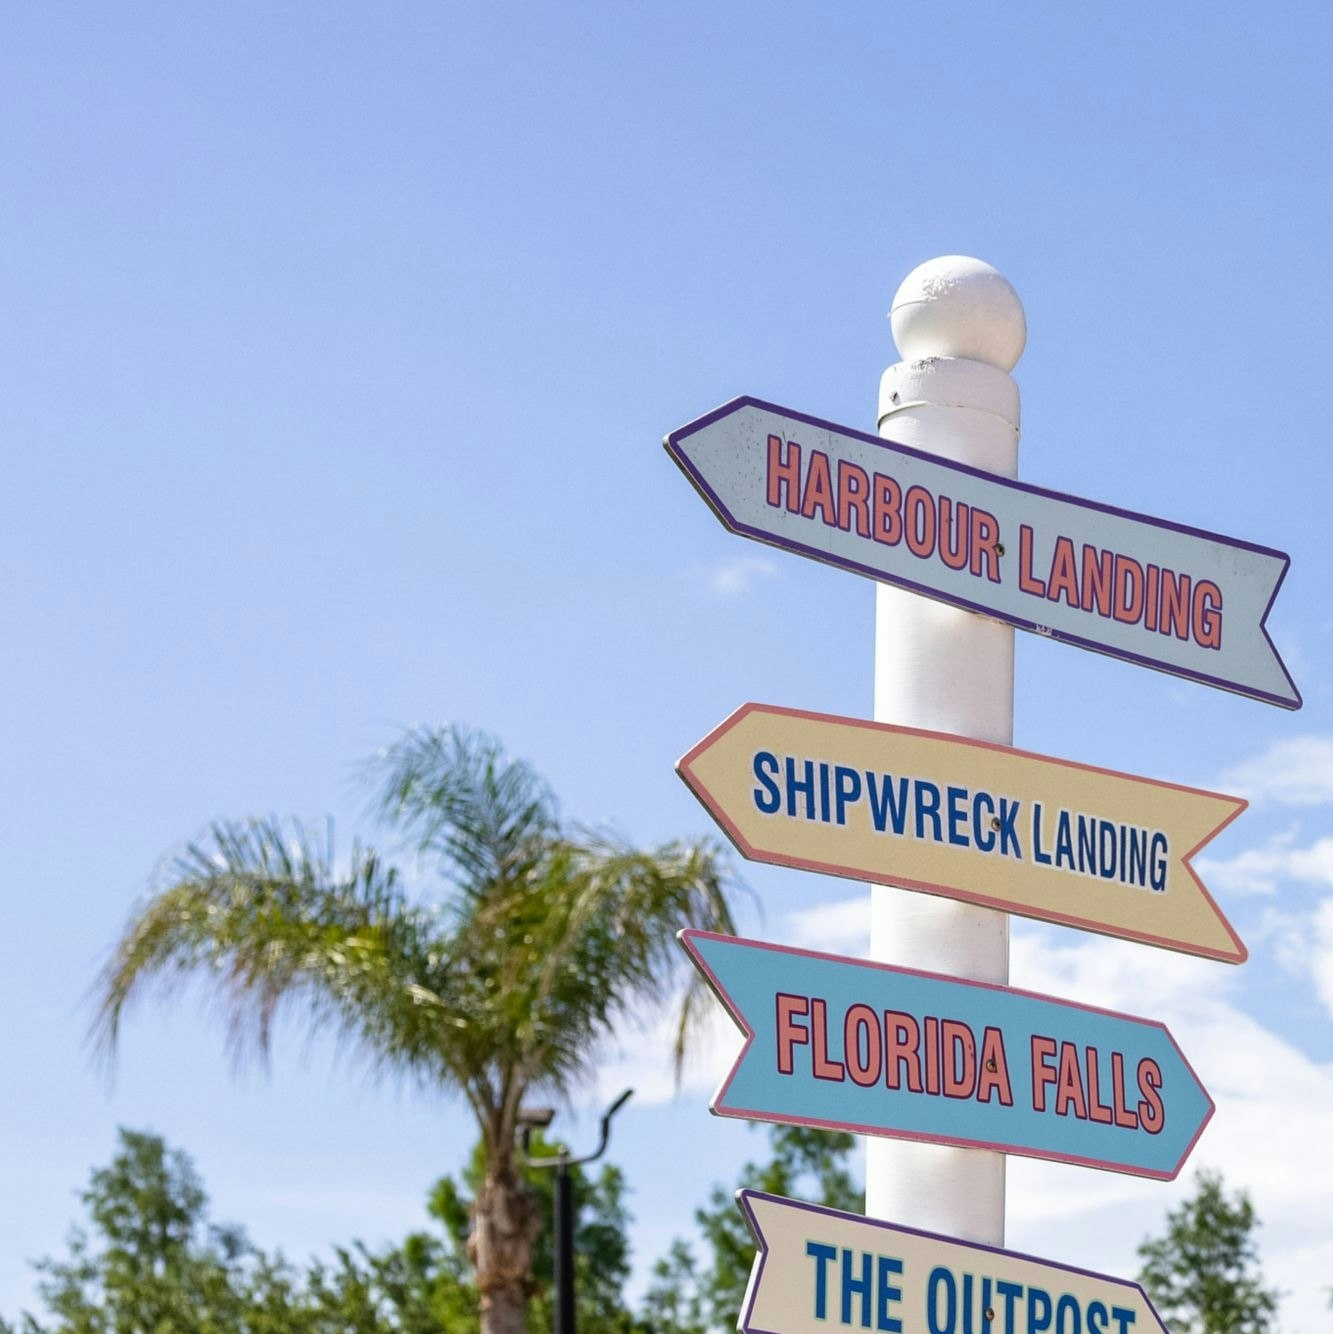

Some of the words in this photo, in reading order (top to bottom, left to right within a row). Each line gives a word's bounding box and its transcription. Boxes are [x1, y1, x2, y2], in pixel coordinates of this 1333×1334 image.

[765, 434, 1002, 583] HARBOUR
[1018, 524, 1224, 651] LANDING
[752, 752, 1023, 858] SHIPWRECK
[1033, 803, 1168, 892] LANDING
[775, 992, 1013, 1106] FLORIDA
[1030, 1035, 1165, 1134] FALLS
[806, 1242, 903, 1334] THE
